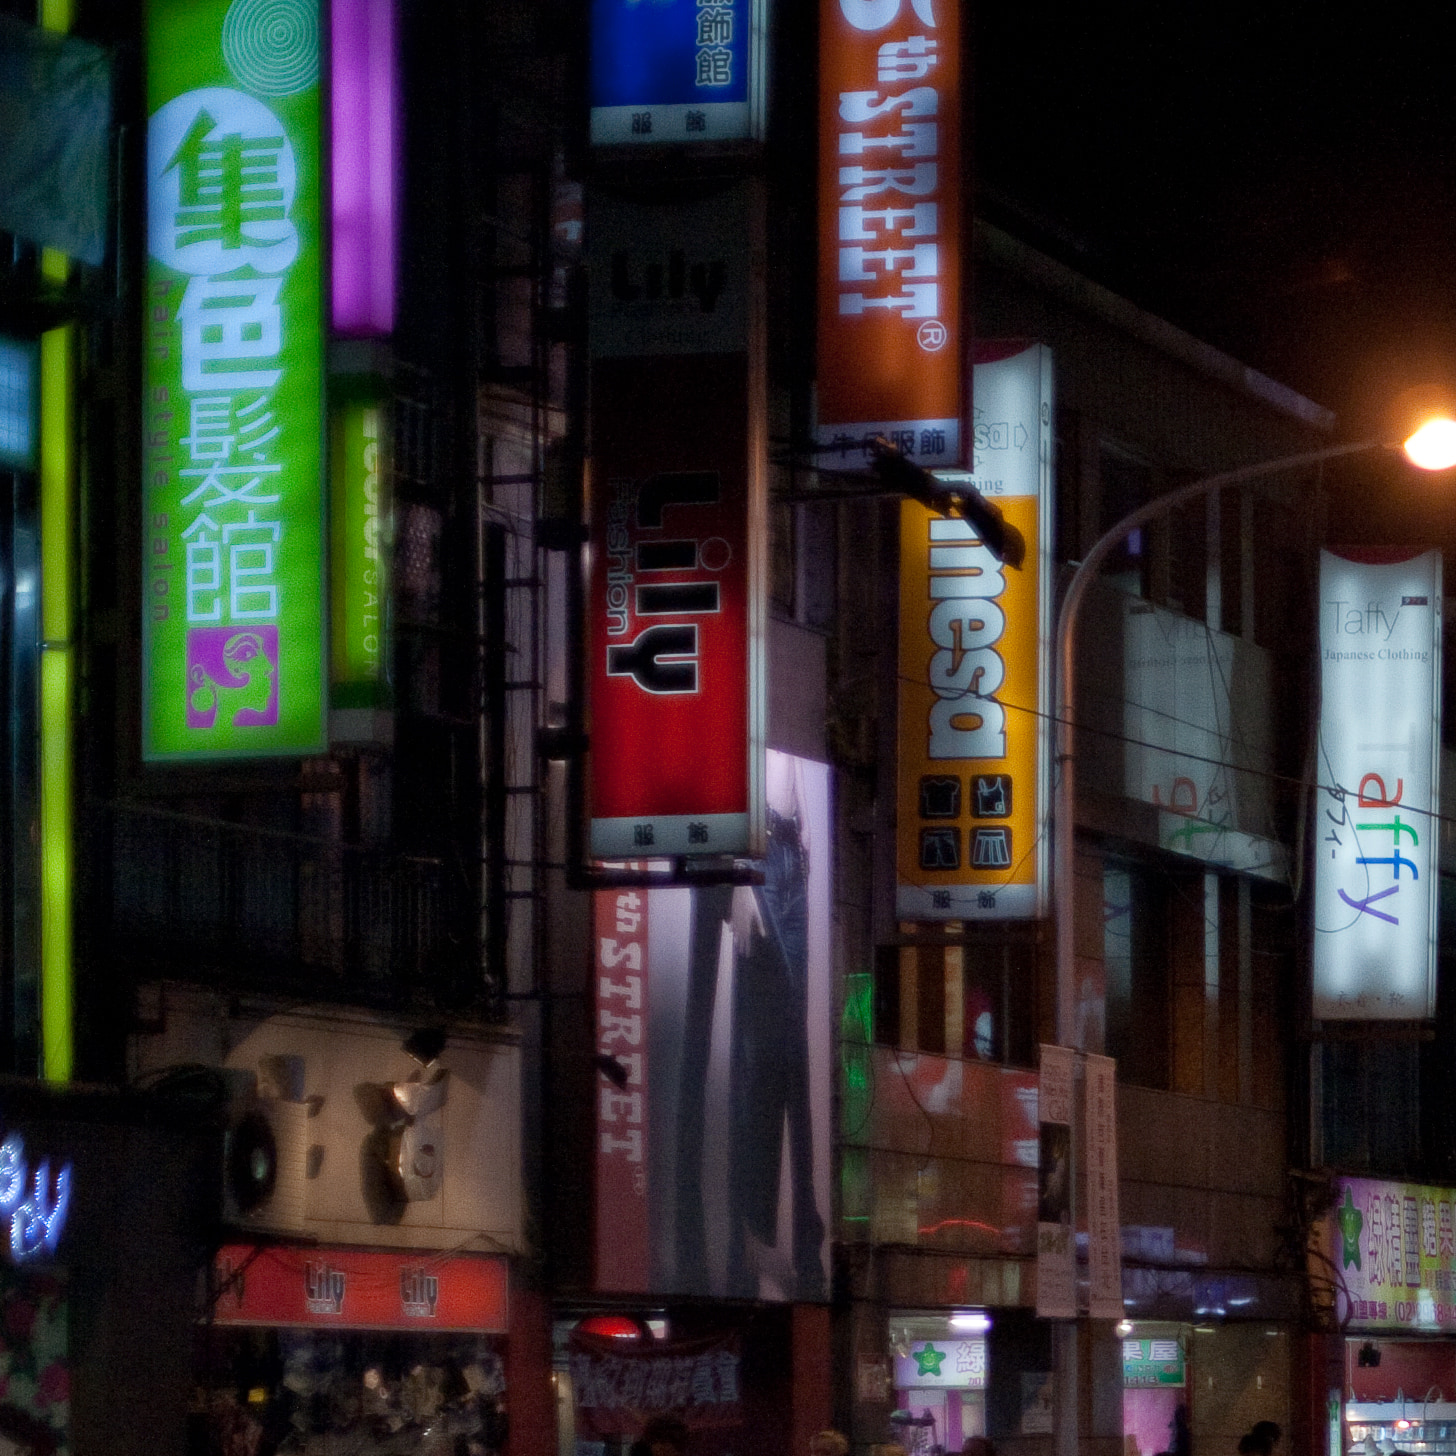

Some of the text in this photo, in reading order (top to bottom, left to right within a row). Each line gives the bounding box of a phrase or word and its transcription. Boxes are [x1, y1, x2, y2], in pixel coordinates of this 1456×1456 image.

[695, 0, 733, 87] 飾館
[837, 86, 938, 318] STREET
[152, 279, 173, 359] hair
[152, 512, 173, 622] salon
[1324, 649, 1429, 664] Japanese Clothing
[1325, 600, 1400, 642] Taffy
[600, 936, 643, 1163] STREET
